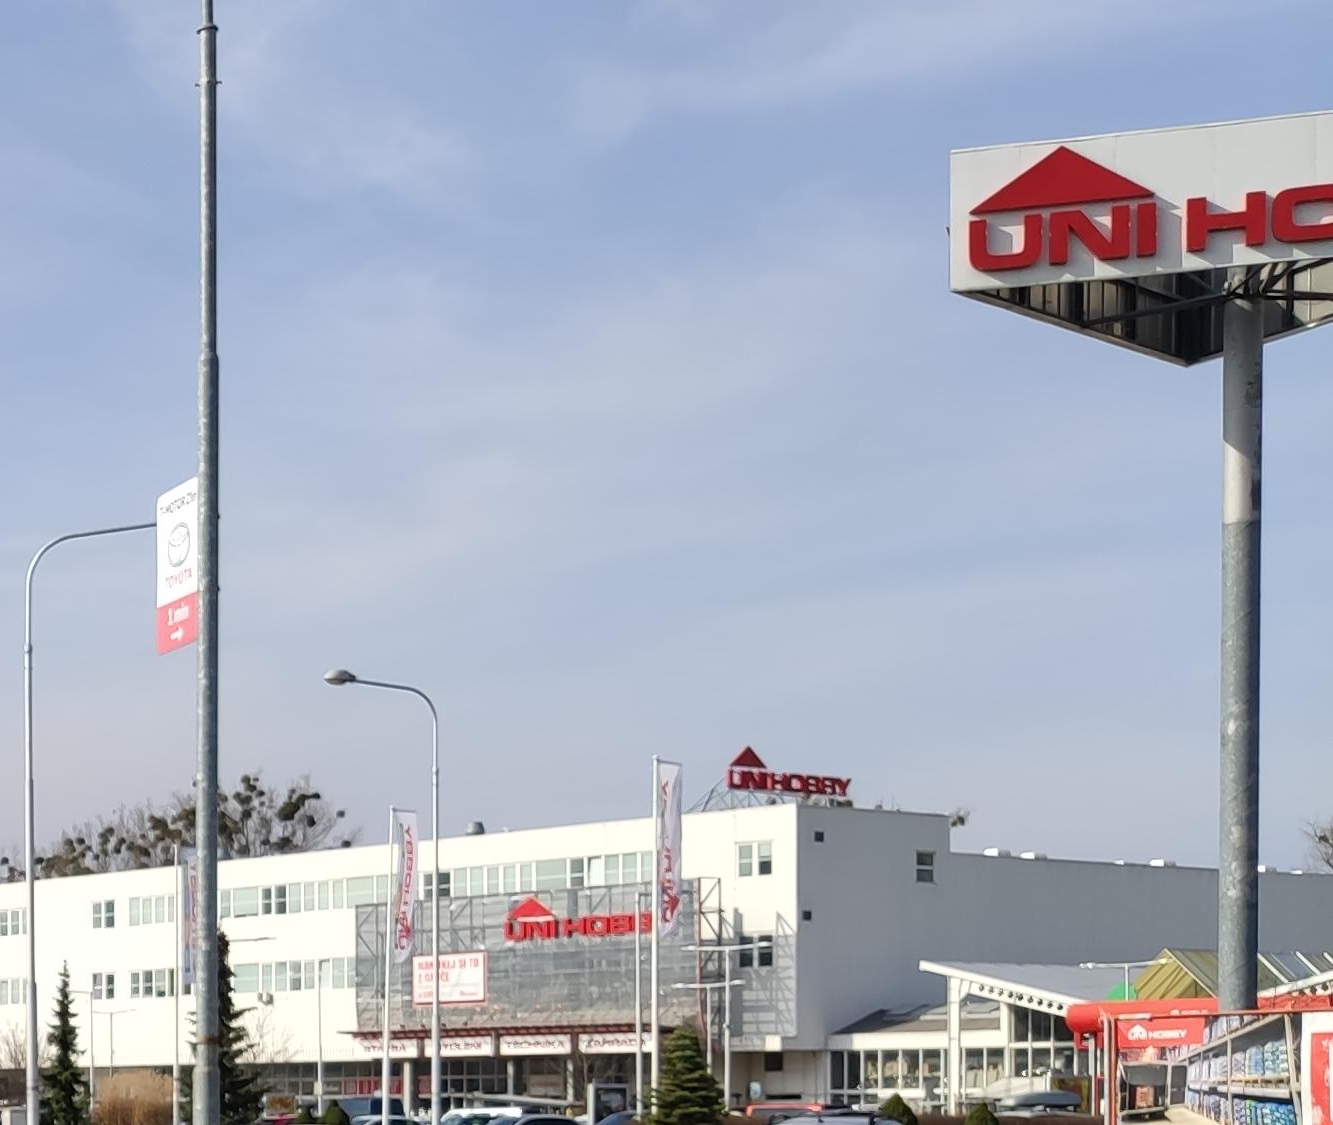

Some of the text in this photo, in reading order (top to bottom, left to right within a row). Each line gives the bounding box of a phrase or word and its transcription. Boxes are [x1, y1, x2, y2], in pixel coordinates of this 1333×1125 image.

[969, 202, 1158, 272] UNI
[167, 602, 189, 626] 1 min
[773, 772, 852, 797] HOBBY
[504, 913, 653, 942] UNI HOBB
